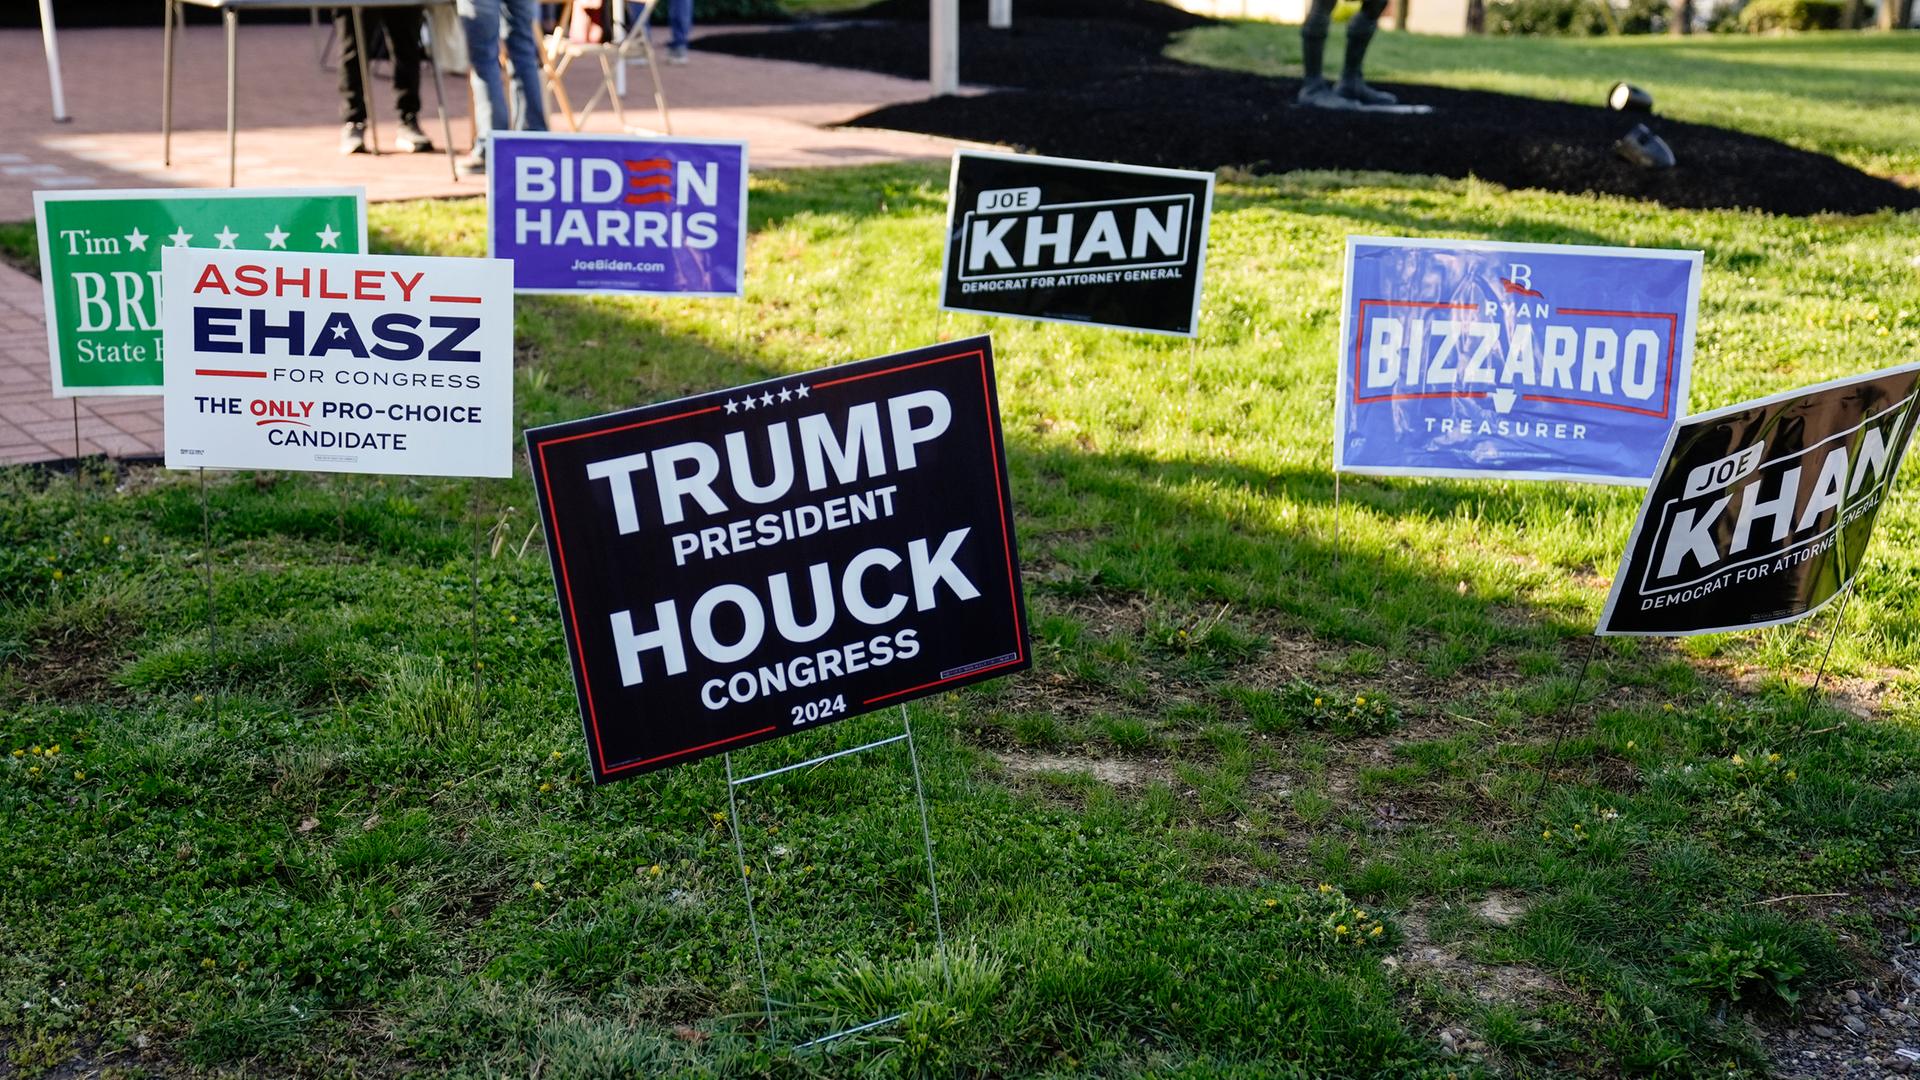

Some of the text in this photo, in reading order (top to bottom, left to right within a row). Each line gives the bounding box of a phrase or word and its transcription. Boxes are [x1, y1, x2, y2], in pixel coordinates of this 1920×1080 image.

[515, 156, 719, 207] BIDEN
[986, 191, 1029, 209] JOE
[60, 229, 121, 256] Tim
[515, 208, 719, 249] HARRIS
[968, 204, 1184, 271] KHAN
[193, 264, 425, 301] ASHLEY
[571, 259, 665, 273] JoeBiden.com
[961, 268, 1183, 294] DEMOCRAT FOR ATTORNEY GENERAL
[1508, 263, 1532, 290] B
[1485, 301, 1550, 319] RYAN
[77, 339, 146, 363] State
[193, 306, 482, 363] EHASZ
[1367, 316, 1661, 400] BIZZARRO
[273, 368, 481, 389] FOR CONGRESS
[195, 396, 482, 423] THE ONLY PRO-CHOICE
[268, 429, 407, 450] CANDIDATE
[1425, 417, 1587, 440] TREASURER
[586, 389, 952, 536] TRUMP
[1696, 450, 1753, 491] JOE
[1656, 409, 1907, 579] KHAN
[672, 485, 897, 566] PRESIDENT
[1640, 573, 1732, 611] DEMOCRAT
[1735, 564, 1769, 585] FOR
[1772, 531, 1837, 574] ATTORNE
[609, 526, 981, 688] HOUCK
[700, 628, 920, 710] CONGRESS
[791, 694, 847, 725] 2024
